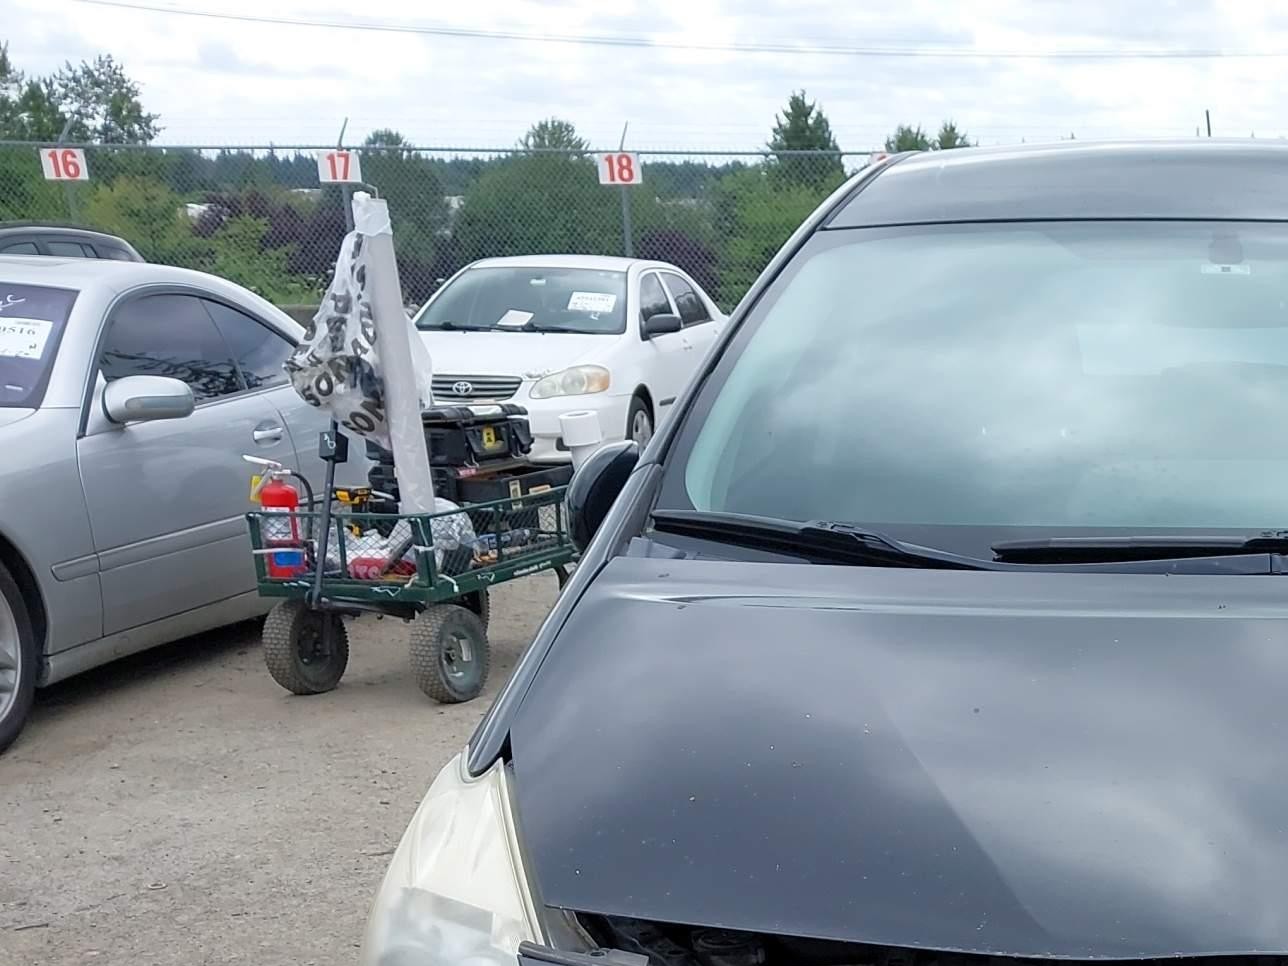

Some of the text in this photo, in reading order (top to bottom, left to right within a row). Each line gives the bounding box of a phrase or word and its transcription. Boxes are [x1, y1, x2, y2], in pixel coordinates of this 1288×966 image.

[48, 150, 80, 178] 16
[326, 153, 350, 180] 17
[605, 154, 634, 182] 18
